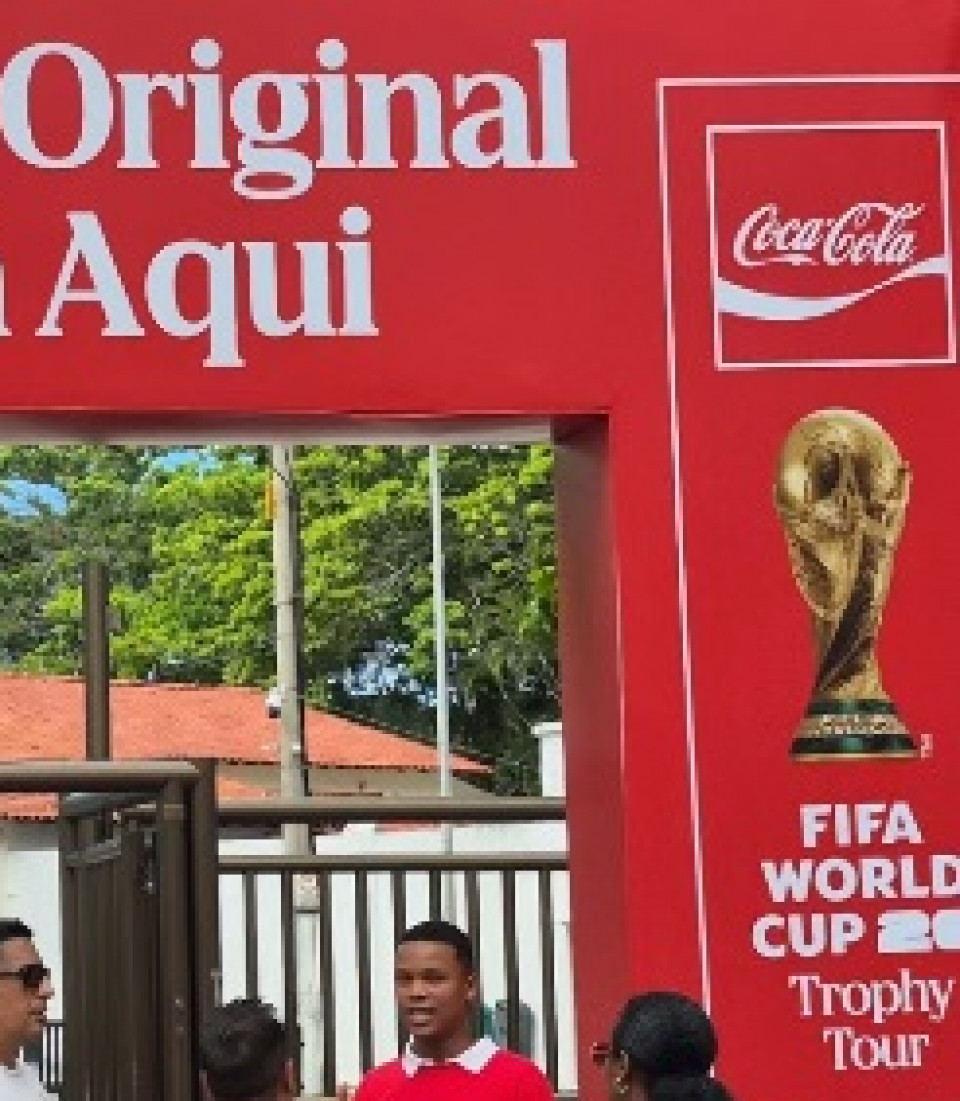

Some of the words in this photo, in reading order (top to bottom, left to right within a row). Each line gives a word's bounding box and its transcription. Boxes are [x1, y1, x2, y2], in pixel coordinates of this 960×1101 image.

[34, 206, 380, 368] Aqui
[799, 802, 923, 848] FIFA
[760, 854, 960, 903] WORLD
[752, 912, 868, 959] CUP
[788, 967, 955, 1024] Trophy
[822, 1026, 930, 1071] Tour
